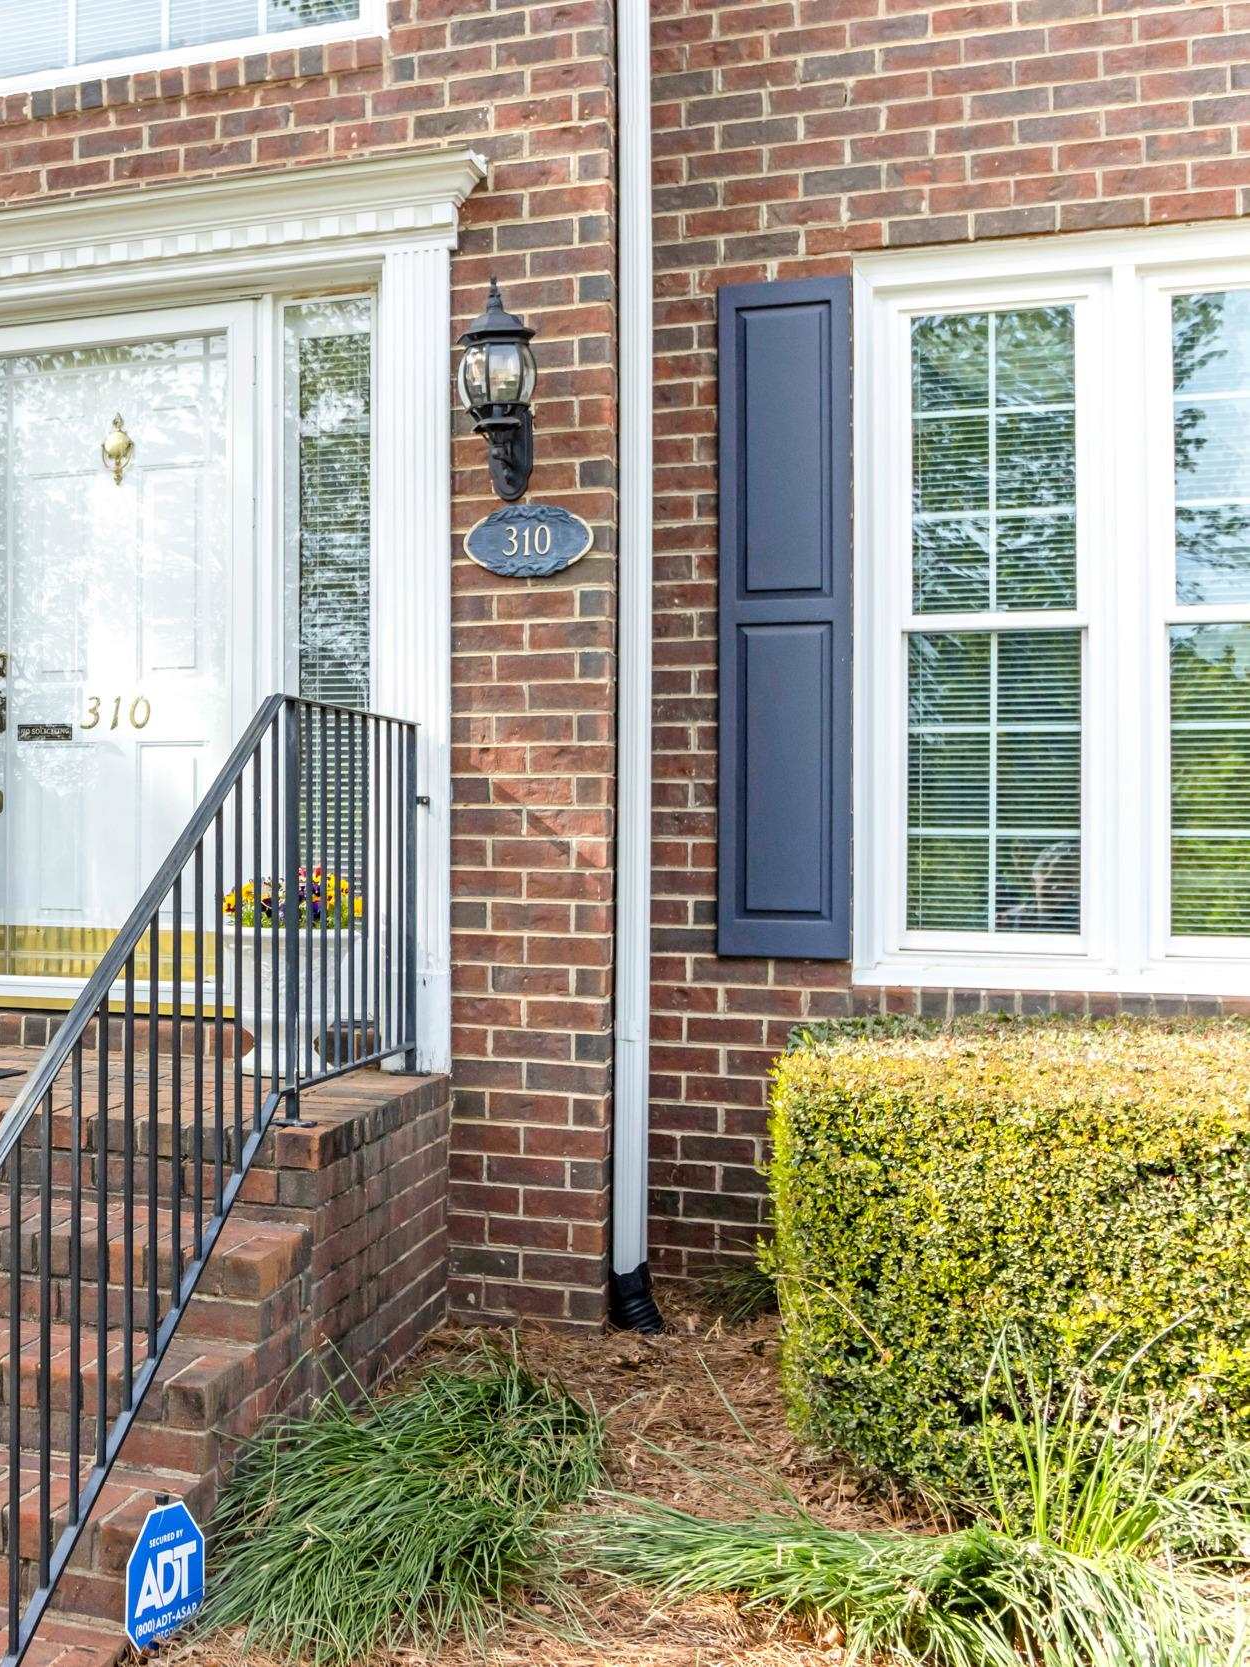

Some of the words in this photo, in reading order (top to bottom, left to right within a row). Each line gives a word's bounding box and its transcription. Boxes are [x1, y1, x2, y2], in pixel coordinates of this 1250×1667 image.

[502, 525, 550, 556] 310
[80, 696, 151, 730] 310
[149, 1531, 175, 1548] SECURED
[175, 1529, 184, 1539] BY
[134, 1540, 196, 1619] ADT
[135, 1617, 155, 1640] (800)
[155, 1602, 197, 1630] ADT-ASAP
